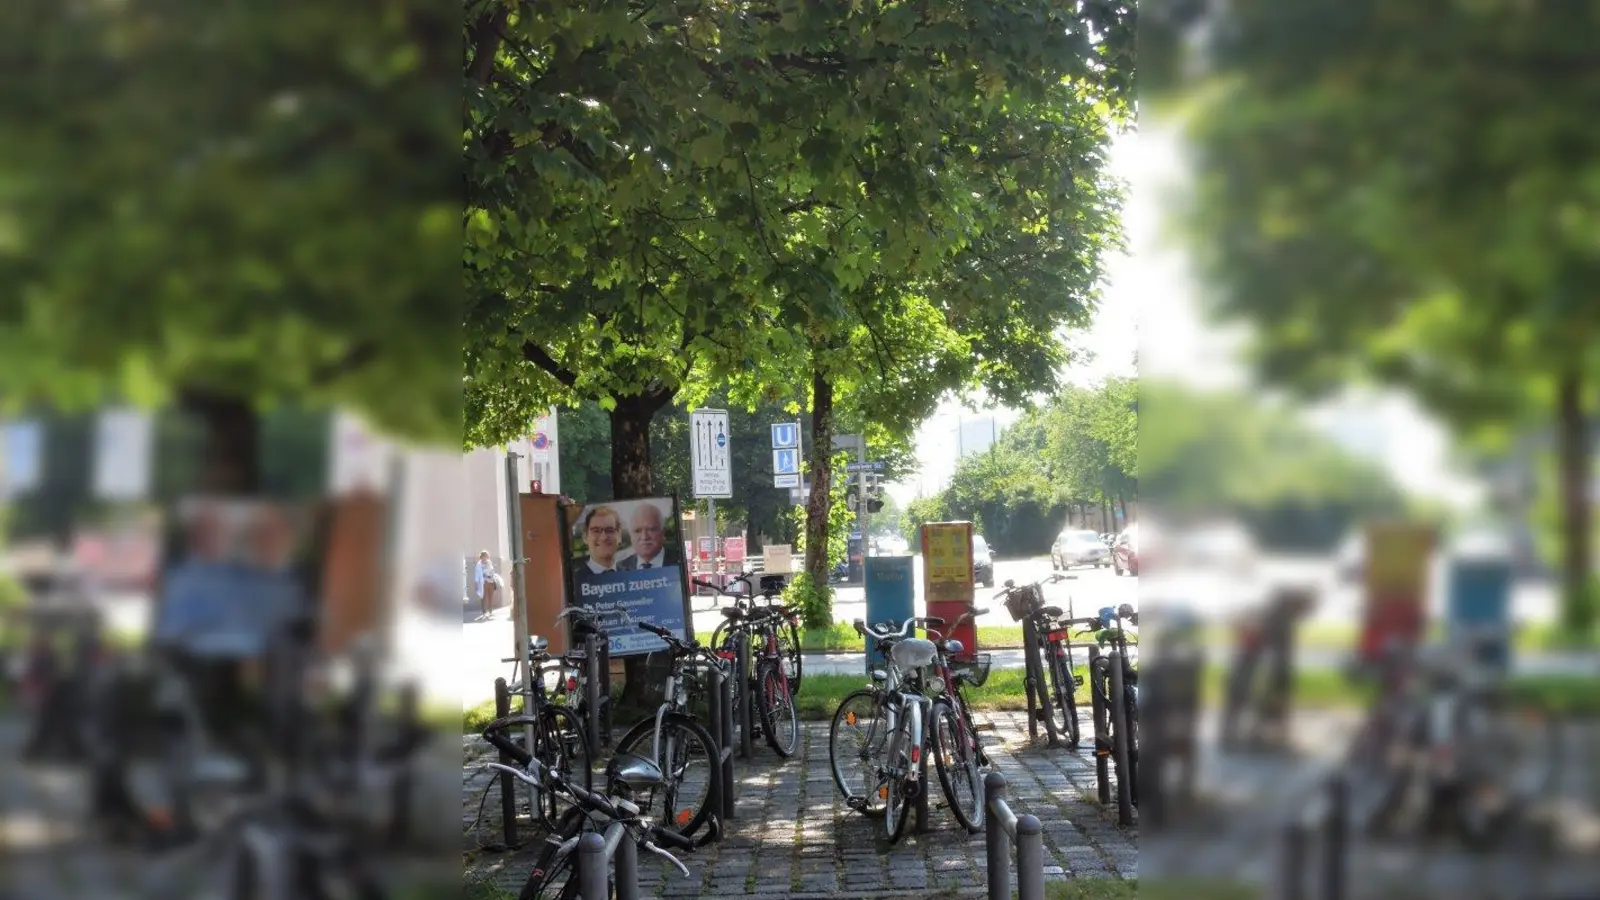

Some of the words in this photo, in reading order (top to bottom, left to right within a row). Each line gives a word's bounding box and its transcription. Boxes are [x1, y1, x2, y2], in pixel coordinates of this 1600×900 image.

[776, 426, 792, 446] U
[581, 582, 625, 598] Bayern
[629, 577, 671, 591] zuerst.
[595, 601, 615, 612] Peter
